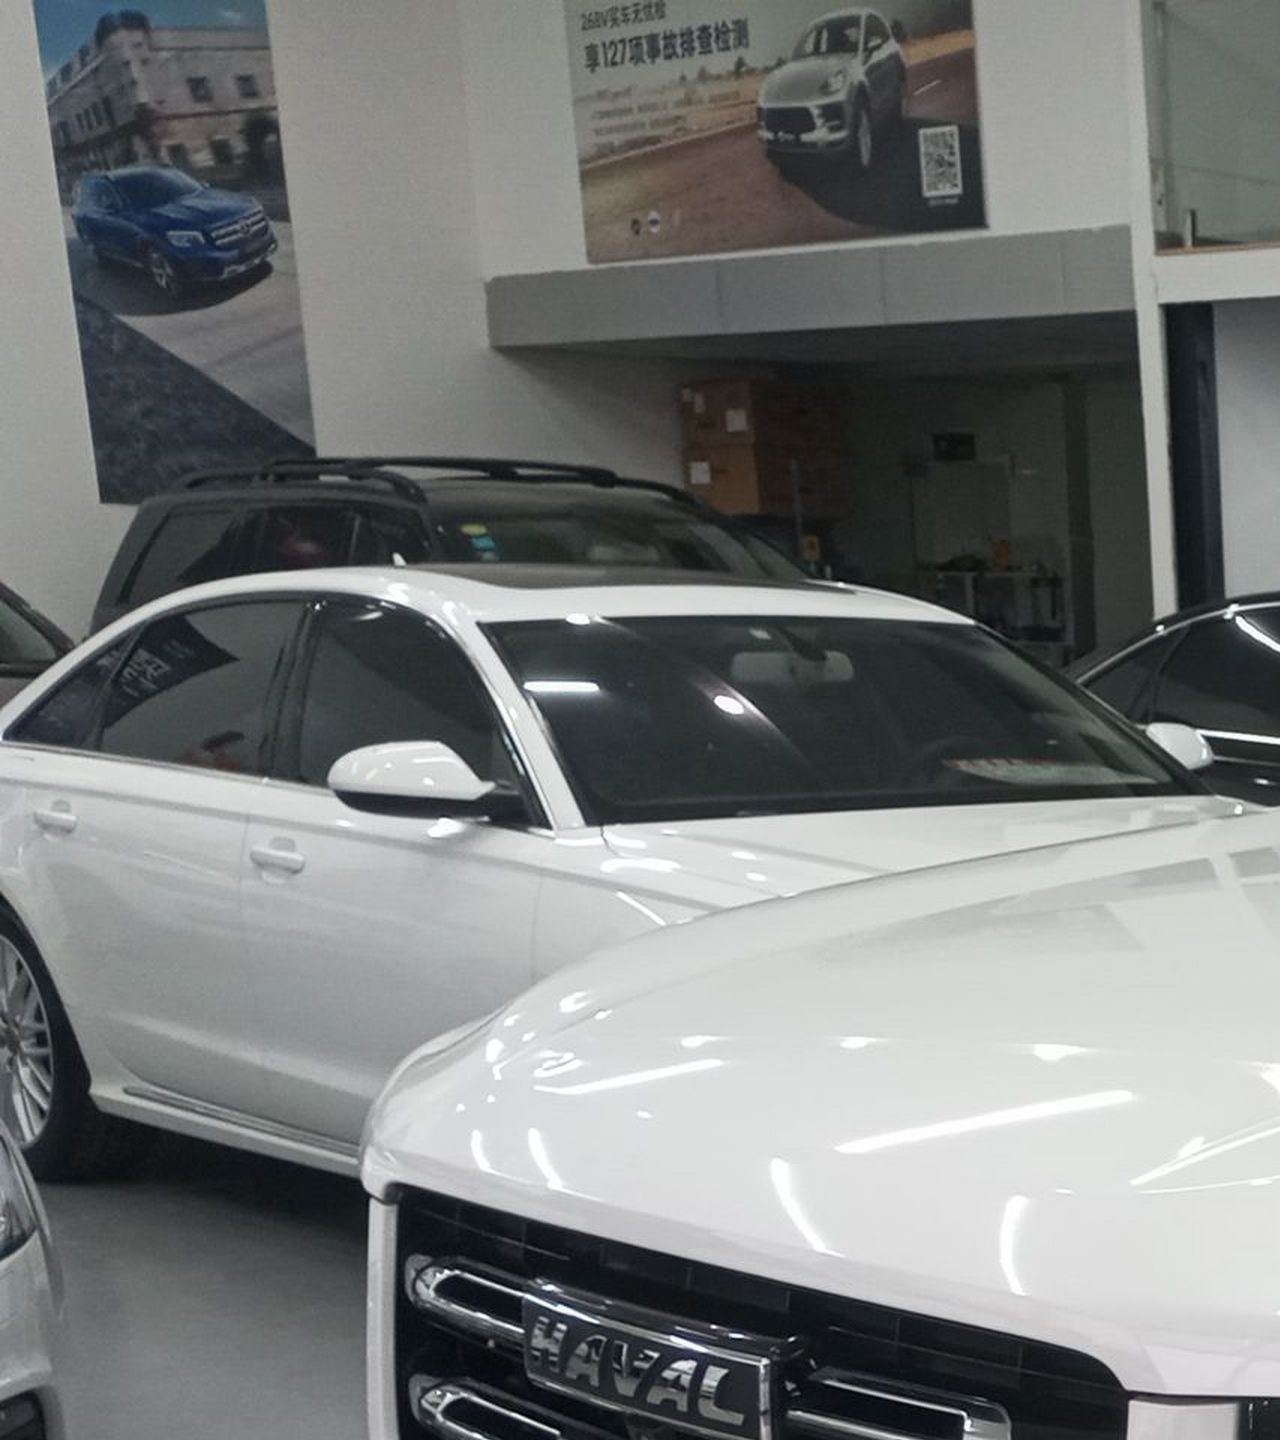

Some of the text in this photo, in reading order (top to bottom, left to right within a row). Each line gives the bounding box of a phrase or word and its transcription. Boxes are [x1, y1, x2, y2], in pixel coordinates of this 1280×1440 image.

[584, 16, 749, 73] 享127项事故排查检测
[531, 1317, 743, 1425] HAVAL
